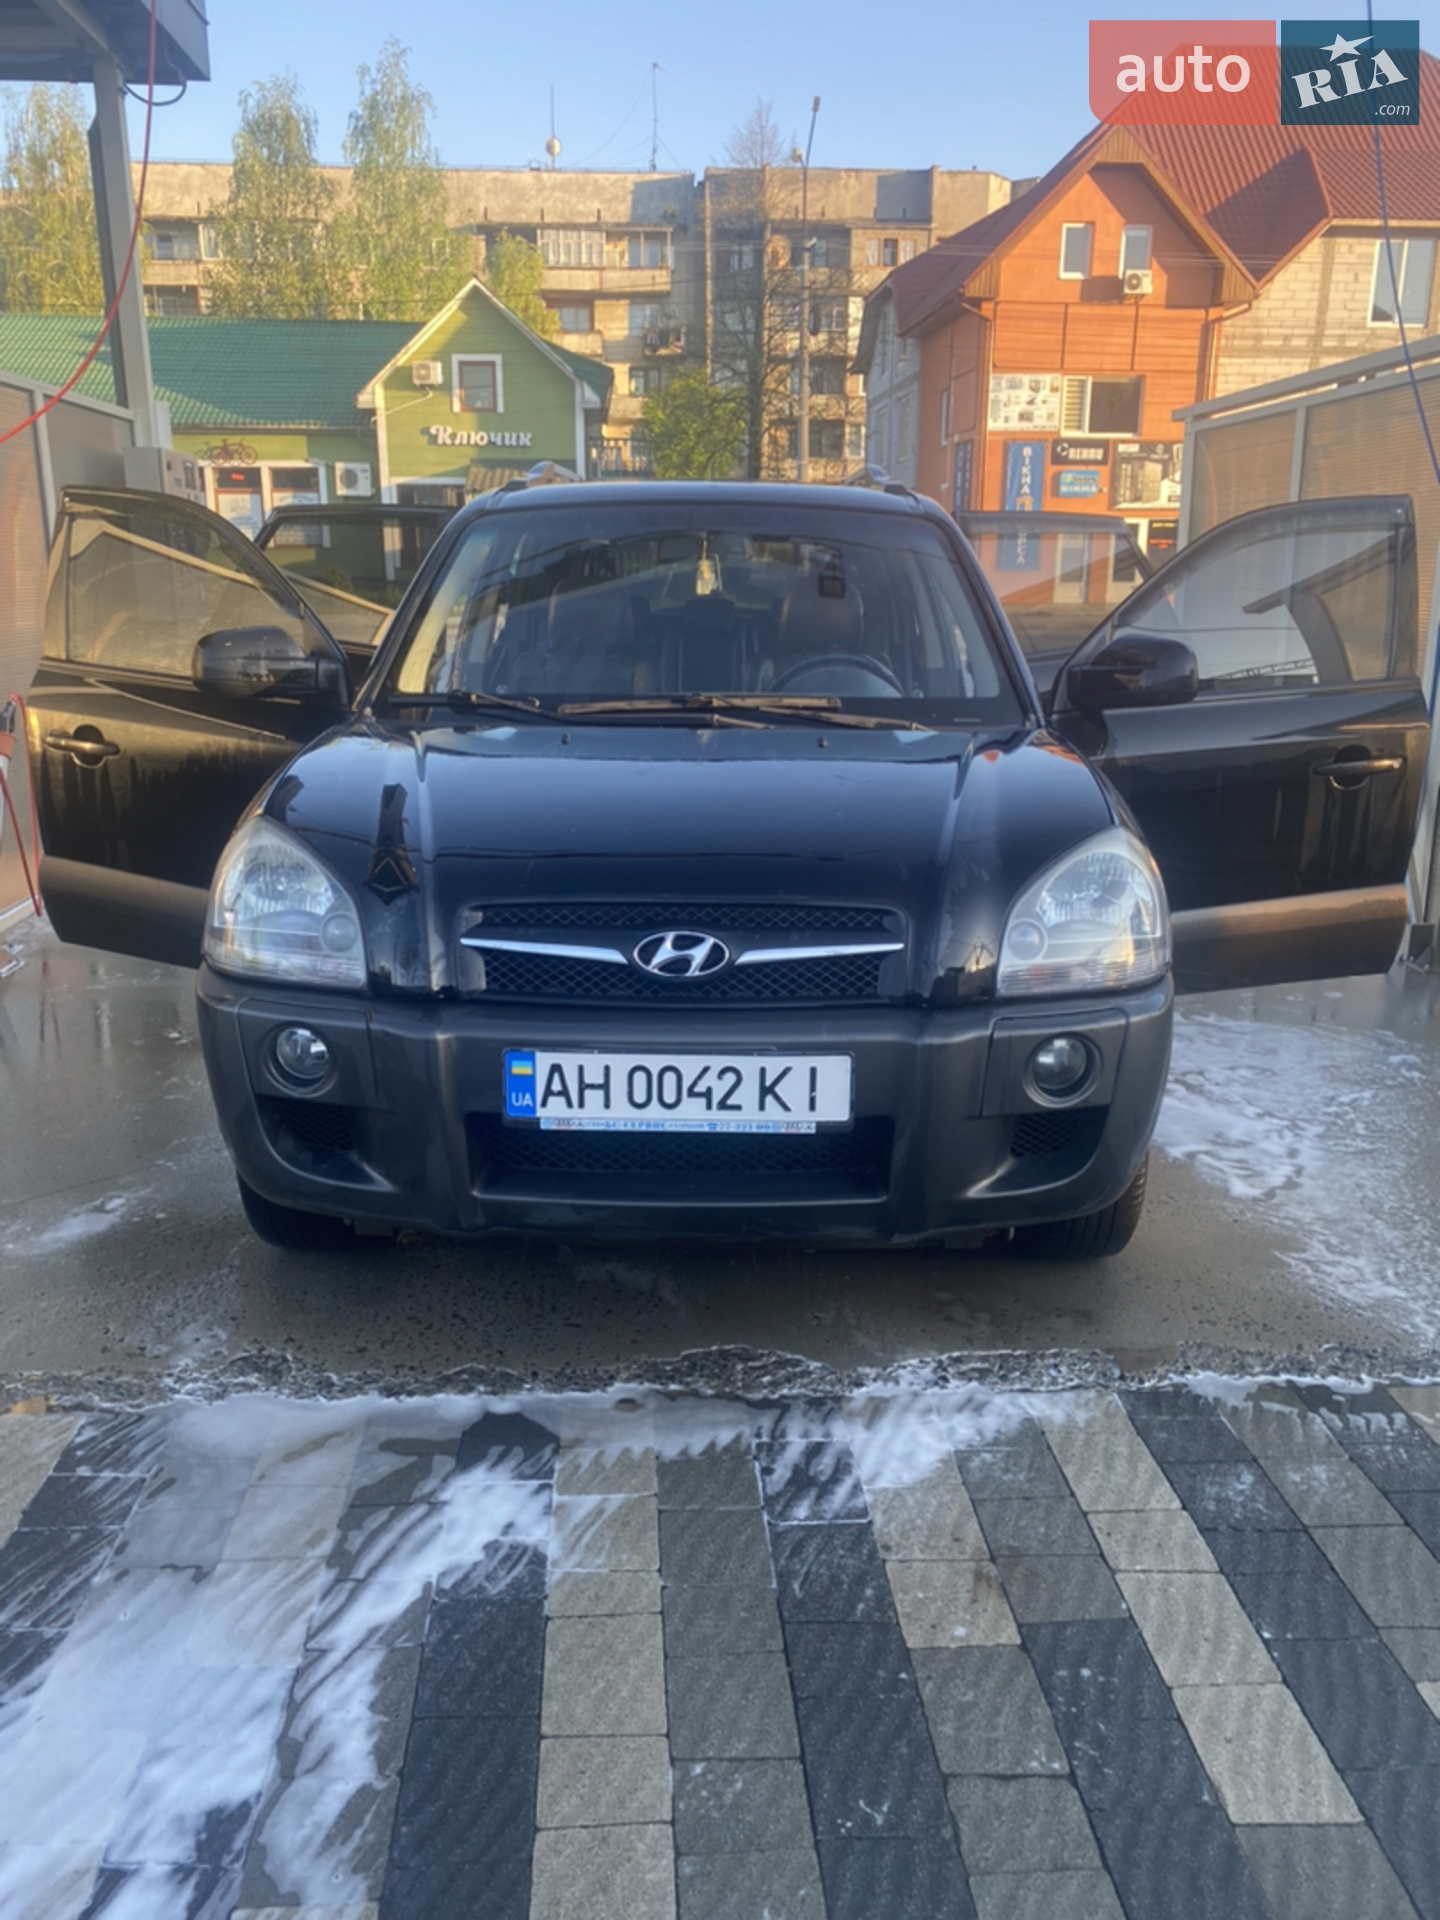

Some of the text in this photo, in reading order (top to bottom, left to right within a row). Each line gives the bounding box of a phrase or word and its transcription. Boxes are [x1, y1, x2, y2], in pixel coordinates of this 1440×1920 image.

[429, 424, 532, 446] Ключик
[540, 1062, 818, 1113] AH 0042 KI
[511, 1092, 534, 1107] UA
